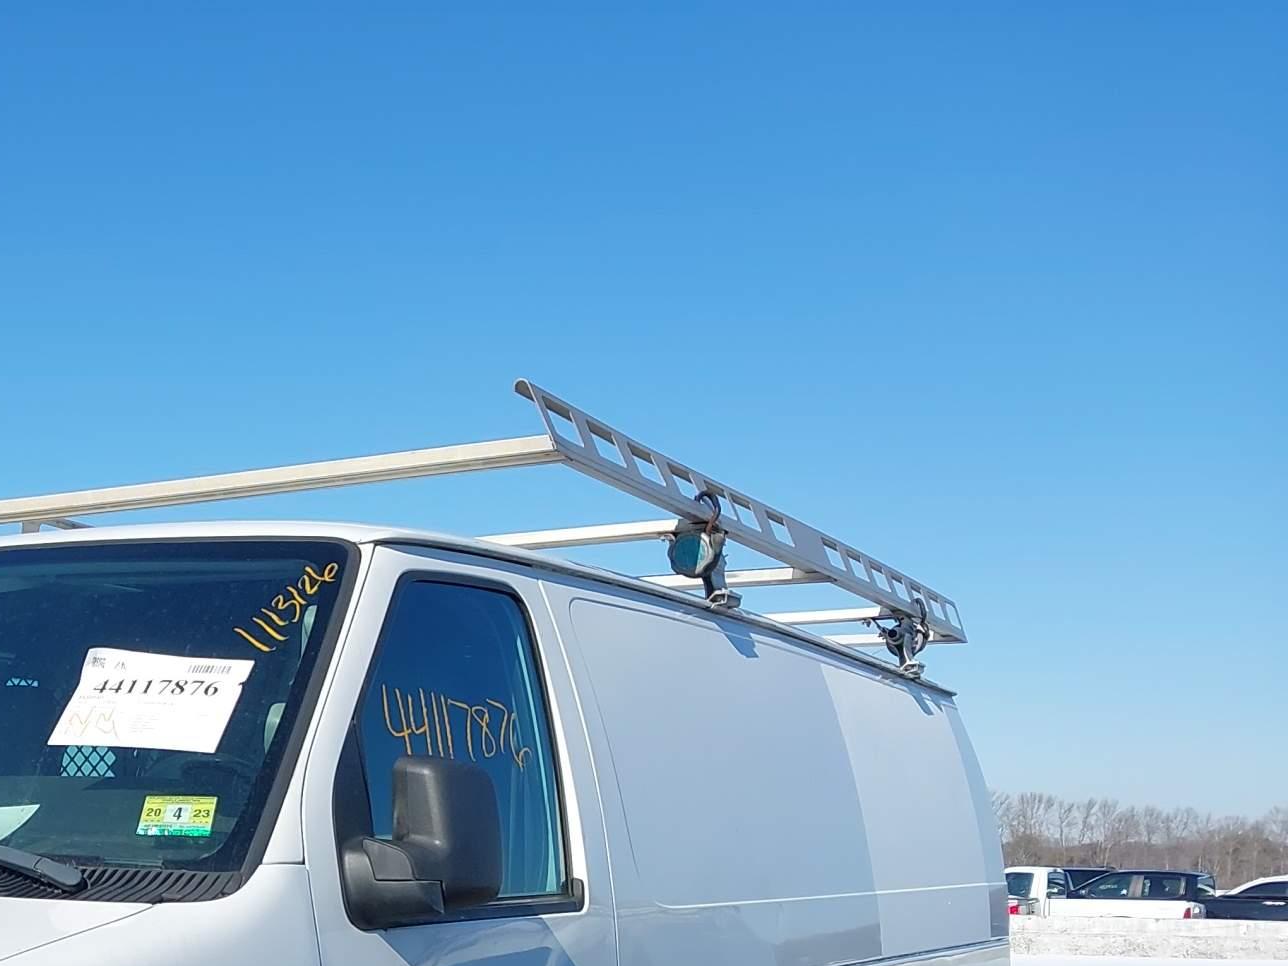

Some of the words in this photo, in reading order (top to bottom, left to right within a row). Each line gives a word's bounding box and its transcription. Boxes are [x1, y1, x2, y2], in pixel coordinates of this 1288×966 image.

[93, 679, 219, 696] 44117876
[382, 684, 532, 772] 44117876
[145, 807, 162, 817] 20
[172, 807, 183, 821] 4
[193, 809, 211, 818] 23
